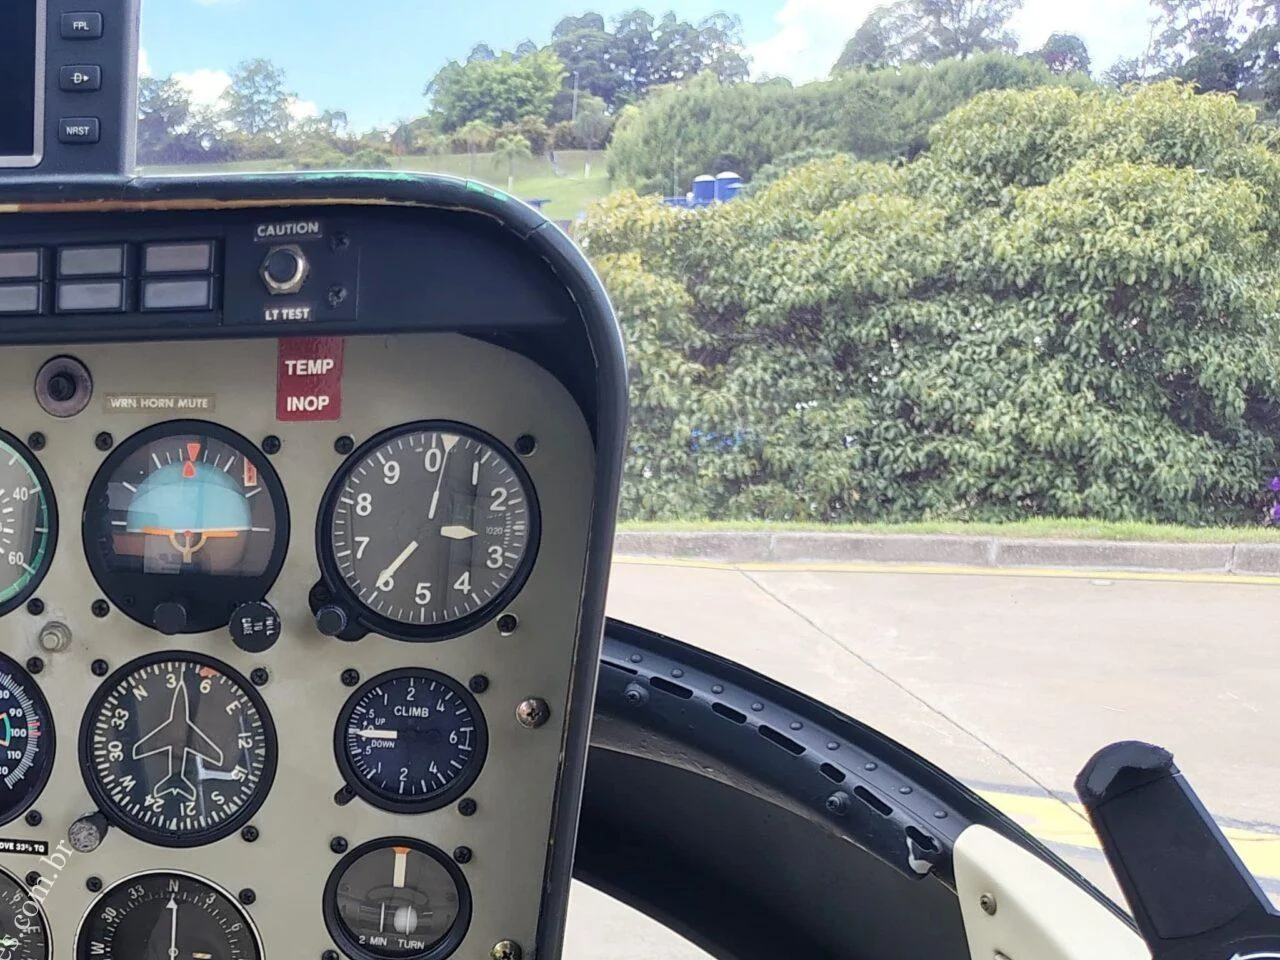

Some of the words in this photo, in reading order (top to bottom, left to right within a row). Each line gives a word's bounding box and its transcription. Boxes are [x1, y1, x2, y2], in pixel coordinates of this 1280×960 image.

[73, 22, 89, 31] FPL
[66, 127, 89, 136] NRST
[257, 222, 319, 237] CAUTION
[265, 309, 278, 320] LT
[282, 308, 309, 319] TEST
[286, 359, 334, 375] TEMP
[111, 398, 137, 408] WRN
[141, 398, 174, 408] HORN
[178, 399, 208, 408] MUTE
[287, 396, 329, 411] INOP
[425, 449, 441, 472] 0
[383, 461, 400, 484] 9
[13, 488, 28, 500] 40
[490, 488, 507, 511] 2
[356, 493, 372, 516] 8
[394, 706, 429, 718] CLIMB
[11, 729, 26, 737] 100
[371, 740, 395, 748] DOWN
[359, 936, 365, 944] 2
[370, 936, 387, 946] MIN
[398, 940, 424, 950] TURN
